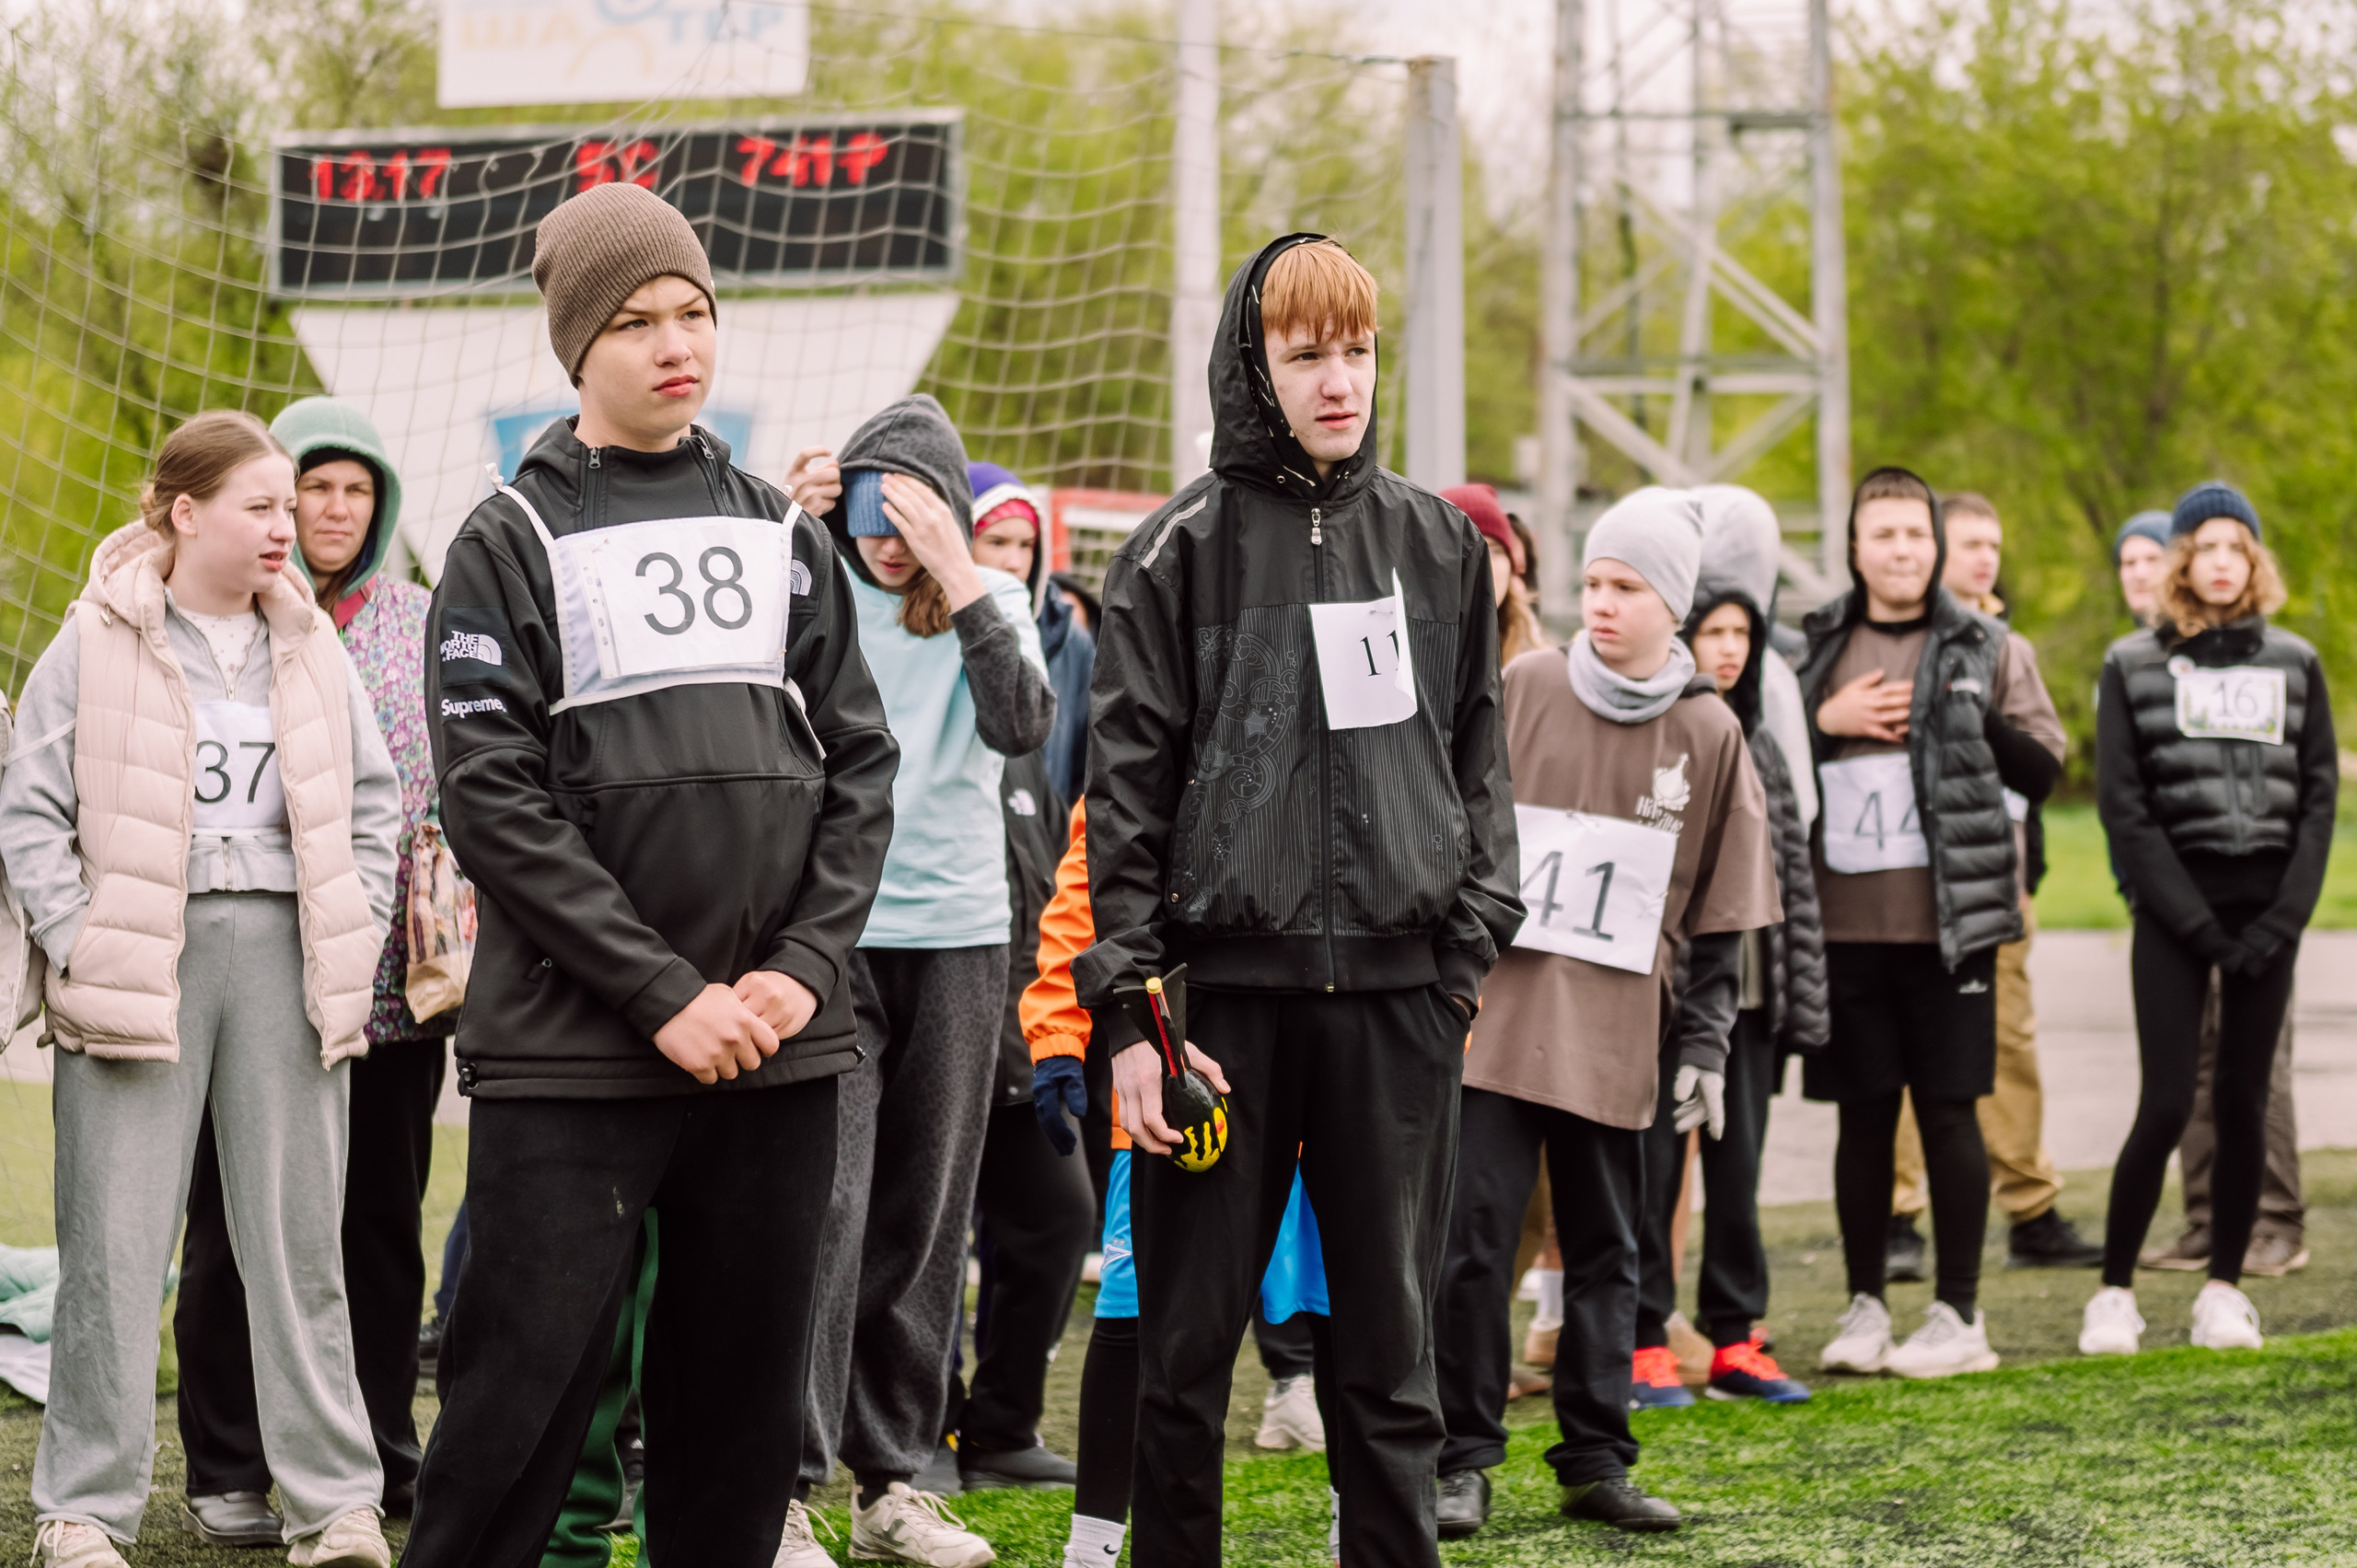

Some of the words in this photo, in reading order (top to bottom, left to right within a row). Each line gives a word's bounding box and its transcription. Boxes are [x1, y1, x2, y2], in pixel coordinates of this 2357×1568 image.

[635, 546, 753, 636] 38
[445, 647, 479, 661] FACE
[451, 631, 479, 645] THE
[2212, 677, 2258, 719] 16
[194, 739, 276, 806] 37
[1519, 850, 1616, 943] 41
